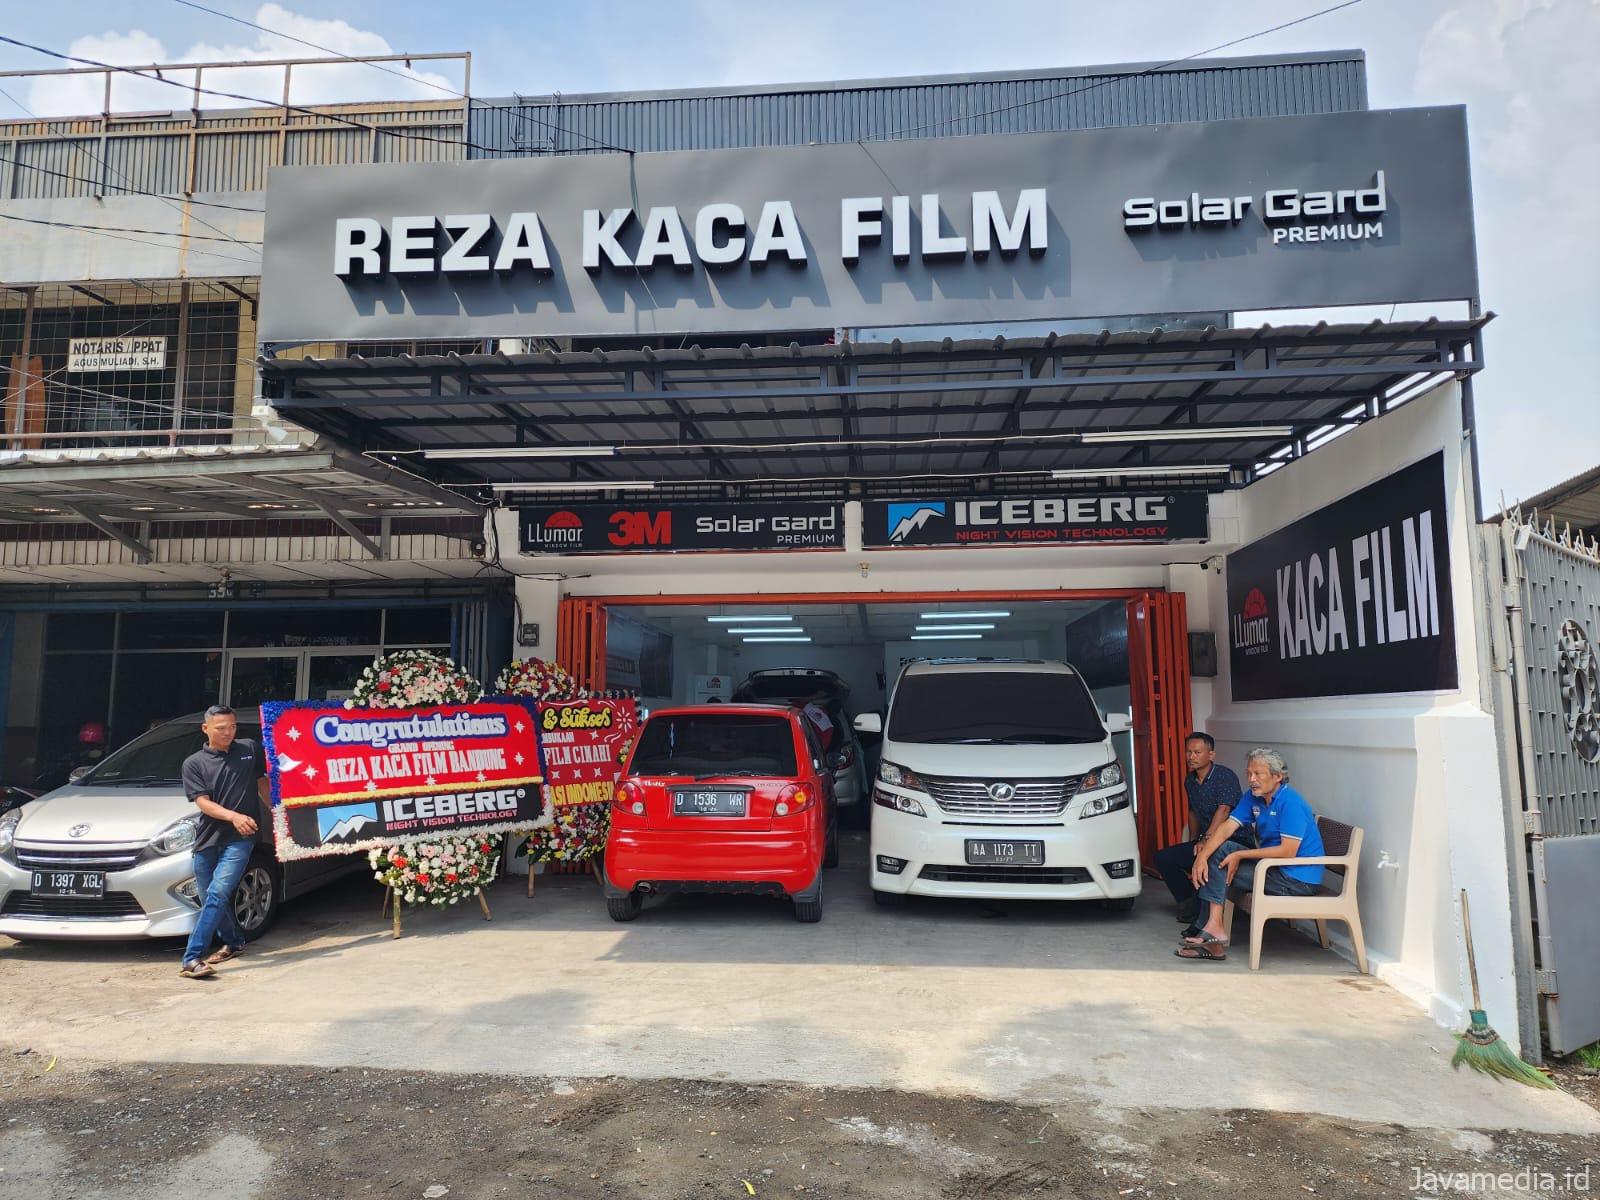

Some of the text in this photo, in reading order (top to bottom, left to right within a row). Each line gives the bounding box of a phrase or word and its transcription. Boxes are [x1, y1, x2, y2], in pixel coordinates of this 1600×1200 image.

[1124, 170, 1386, 229] Solar Gard
[334, 188, 1047, 279] REZA KACA FILM
[1273, 222, 1384, 244] PREMIUM
[73, 342, 124, 355] NOTARIS
[133, 340, 163, 353] PPAT
[74, 358, 98, 367] AGUS
[607, 510, 672, 546] 3M
[696, 507, 836, 533] Solar Gard
[528, 523, 584, 543] LLumar
[777, 534, 836, 544] PREMIUM
[956, 526, 1169, 541] NIGHT VISION TECHNOLOGY
[1276, 509, 1440, 660] KACA FILM
[1233, 613, 1269, 649] LLumar
[315, 712, 506, 747] Congratulations
[543, 707, 612, 730] & Sukses
[388, 740, 454, 754] GRAND OPENING
[543, 744, 612, 766] FILM CIMAHI
[326, 748, 507, 783] REZA KACA FILM BANDUNG
[676, 793, 742, 806] D 1536 WR
[386, 808, 519, 831] NIGHT VISION TECHNOLOGY
[973, 843, 1037, 857] AA 1173 TT
[34, 873, 101, 889] D 1397 XGL
